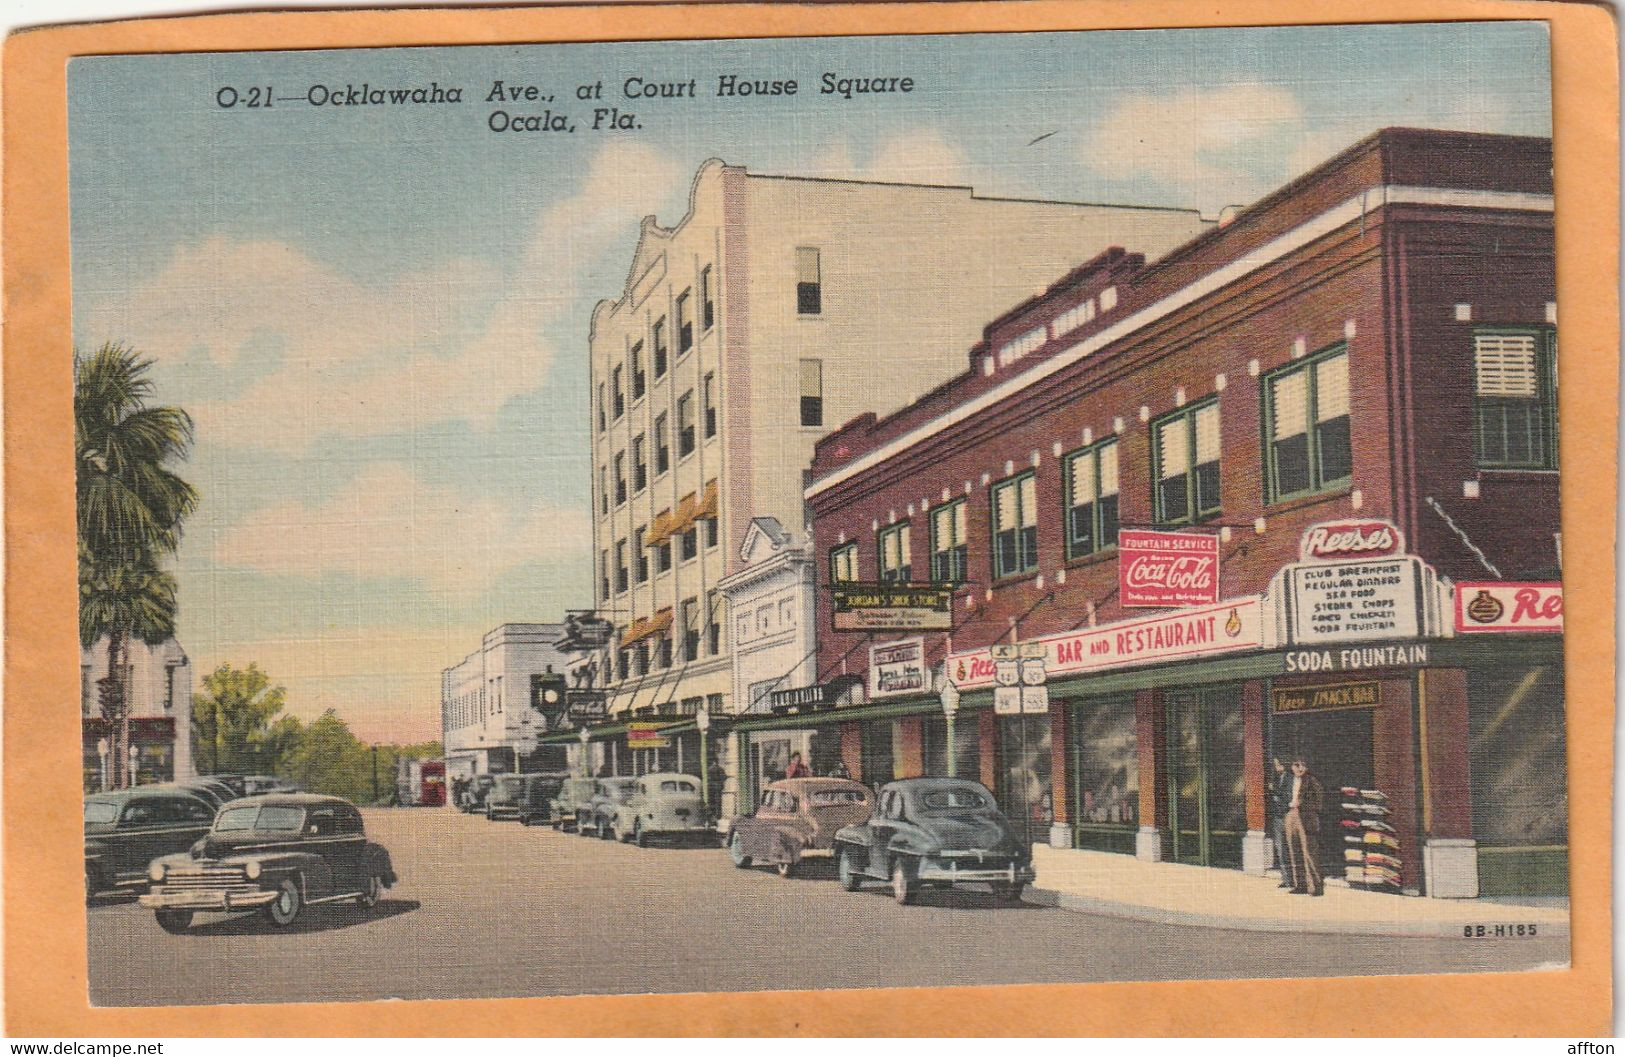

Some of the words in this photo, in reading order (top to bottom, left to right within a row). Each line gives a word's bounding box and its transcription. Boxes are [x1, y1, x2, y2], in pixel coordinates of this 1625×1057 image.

[1125, 539, 1170, 549] FOUNTAIN
[1172, 540, 1213, 550] SERVICE
[1057, 640, 1083, 664] BAR
[1090, 640, 1109, 656] AND
[1116, 616, 1216, 655] RESTAURANT
[1286, 651, 1333, 671] SODA
[1341, 646, 1427, 670] FOUNTAIN
